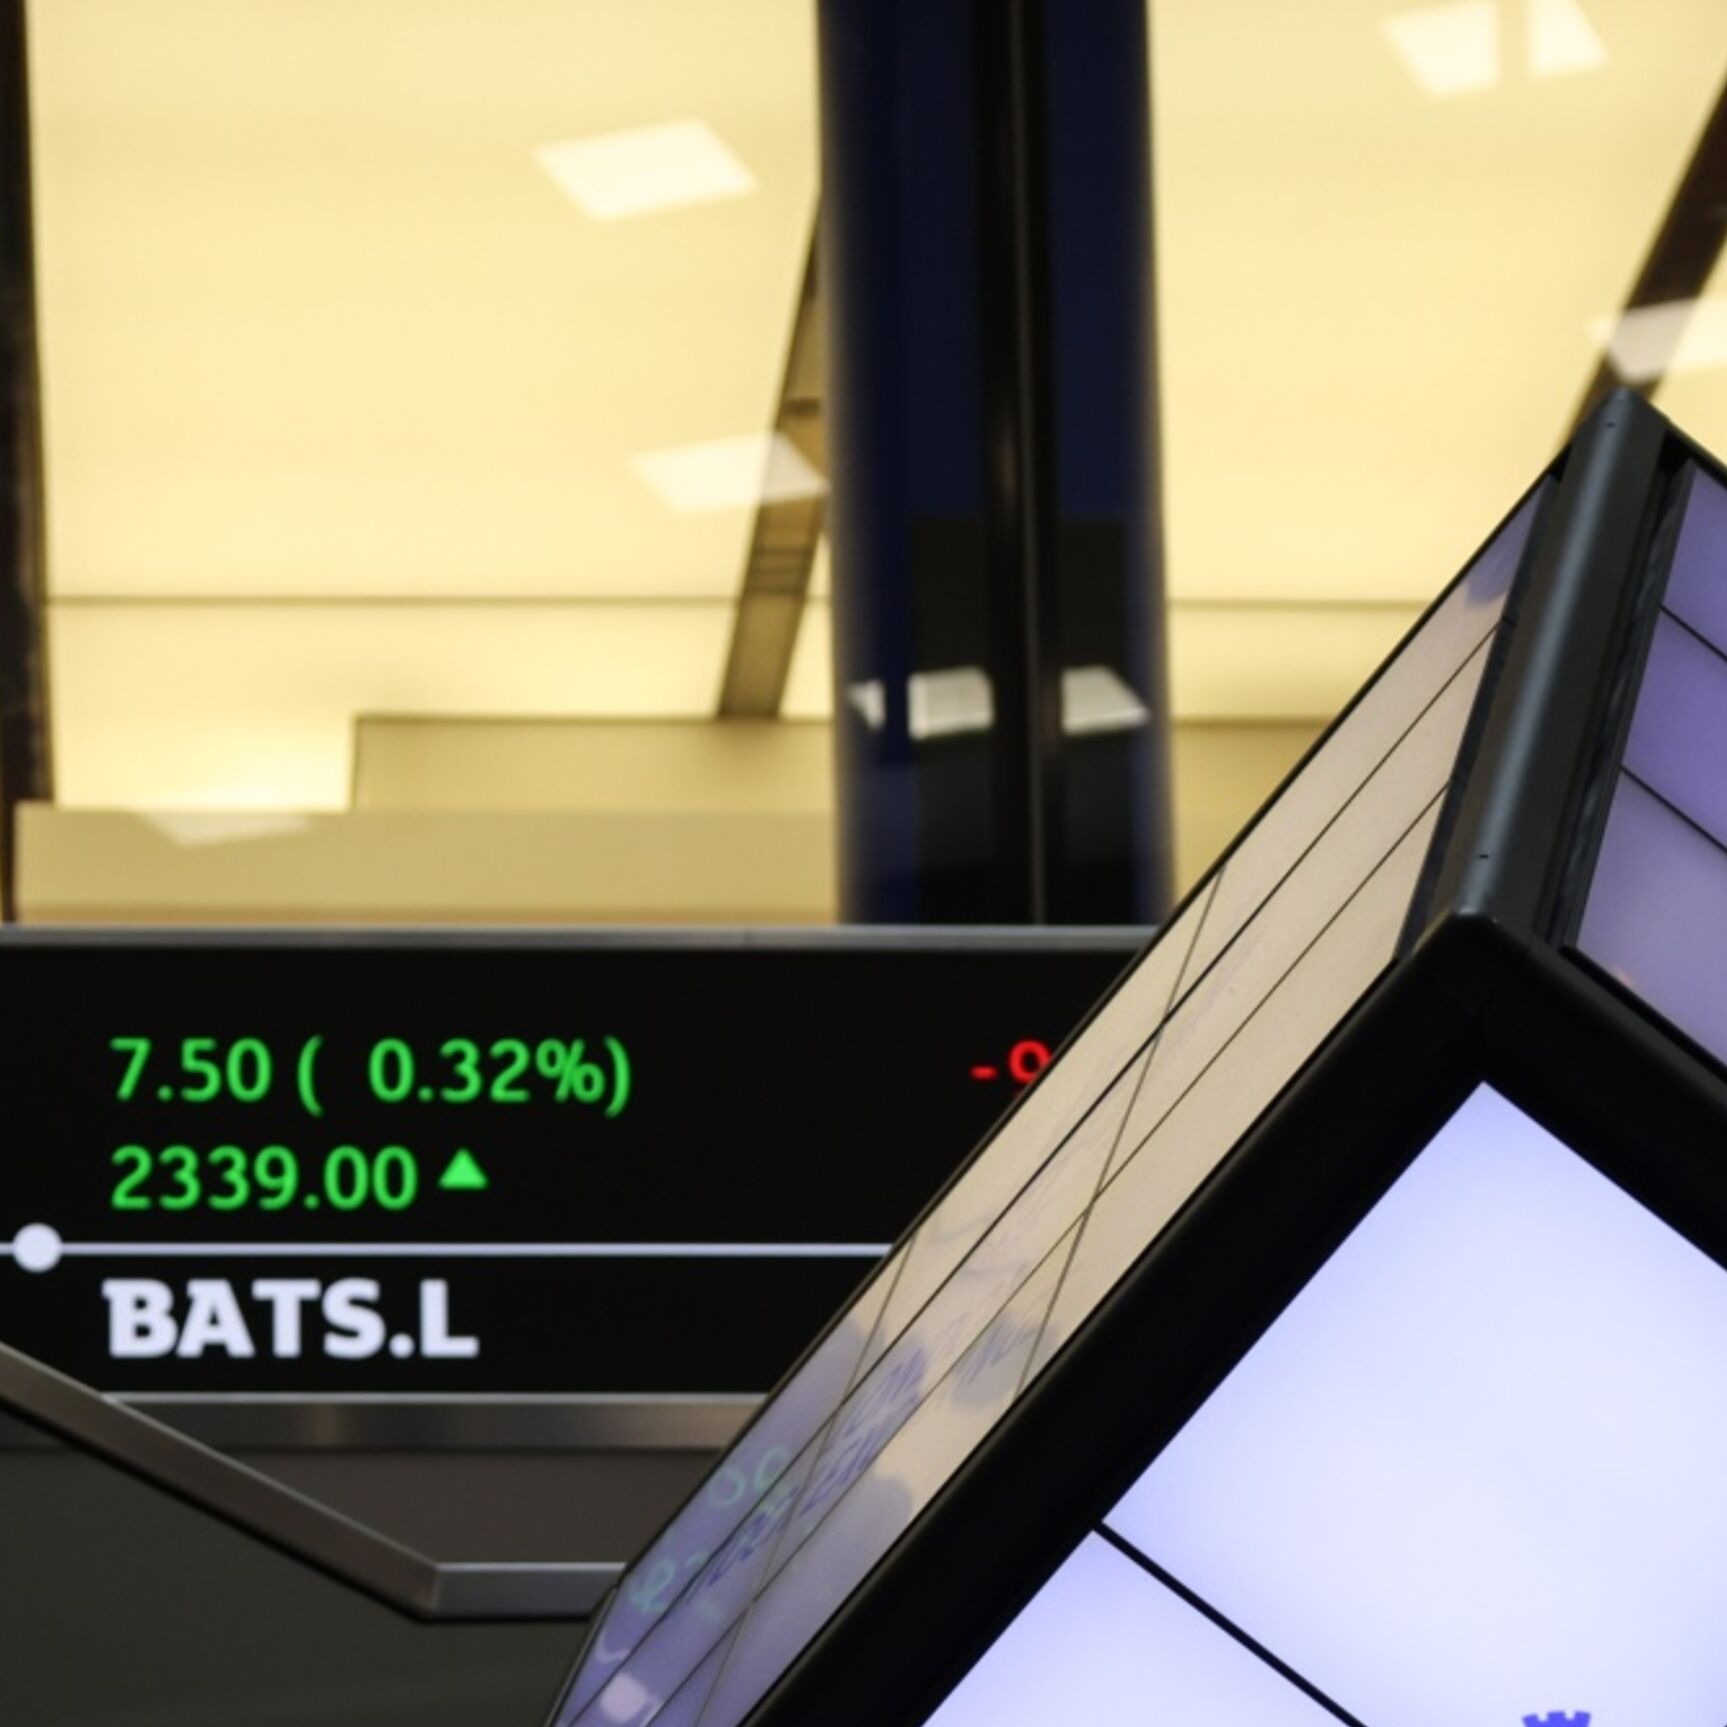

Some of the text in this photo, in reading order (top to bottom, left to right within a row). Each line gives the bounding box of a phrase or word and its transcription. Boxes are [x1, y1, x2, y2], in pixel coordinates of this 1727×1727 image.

[111, 1036, 273, 1103] 7.50
[111, 1144, 419, 1211] 2339.00
[102, 1279, 479, 1358] BATS.L
